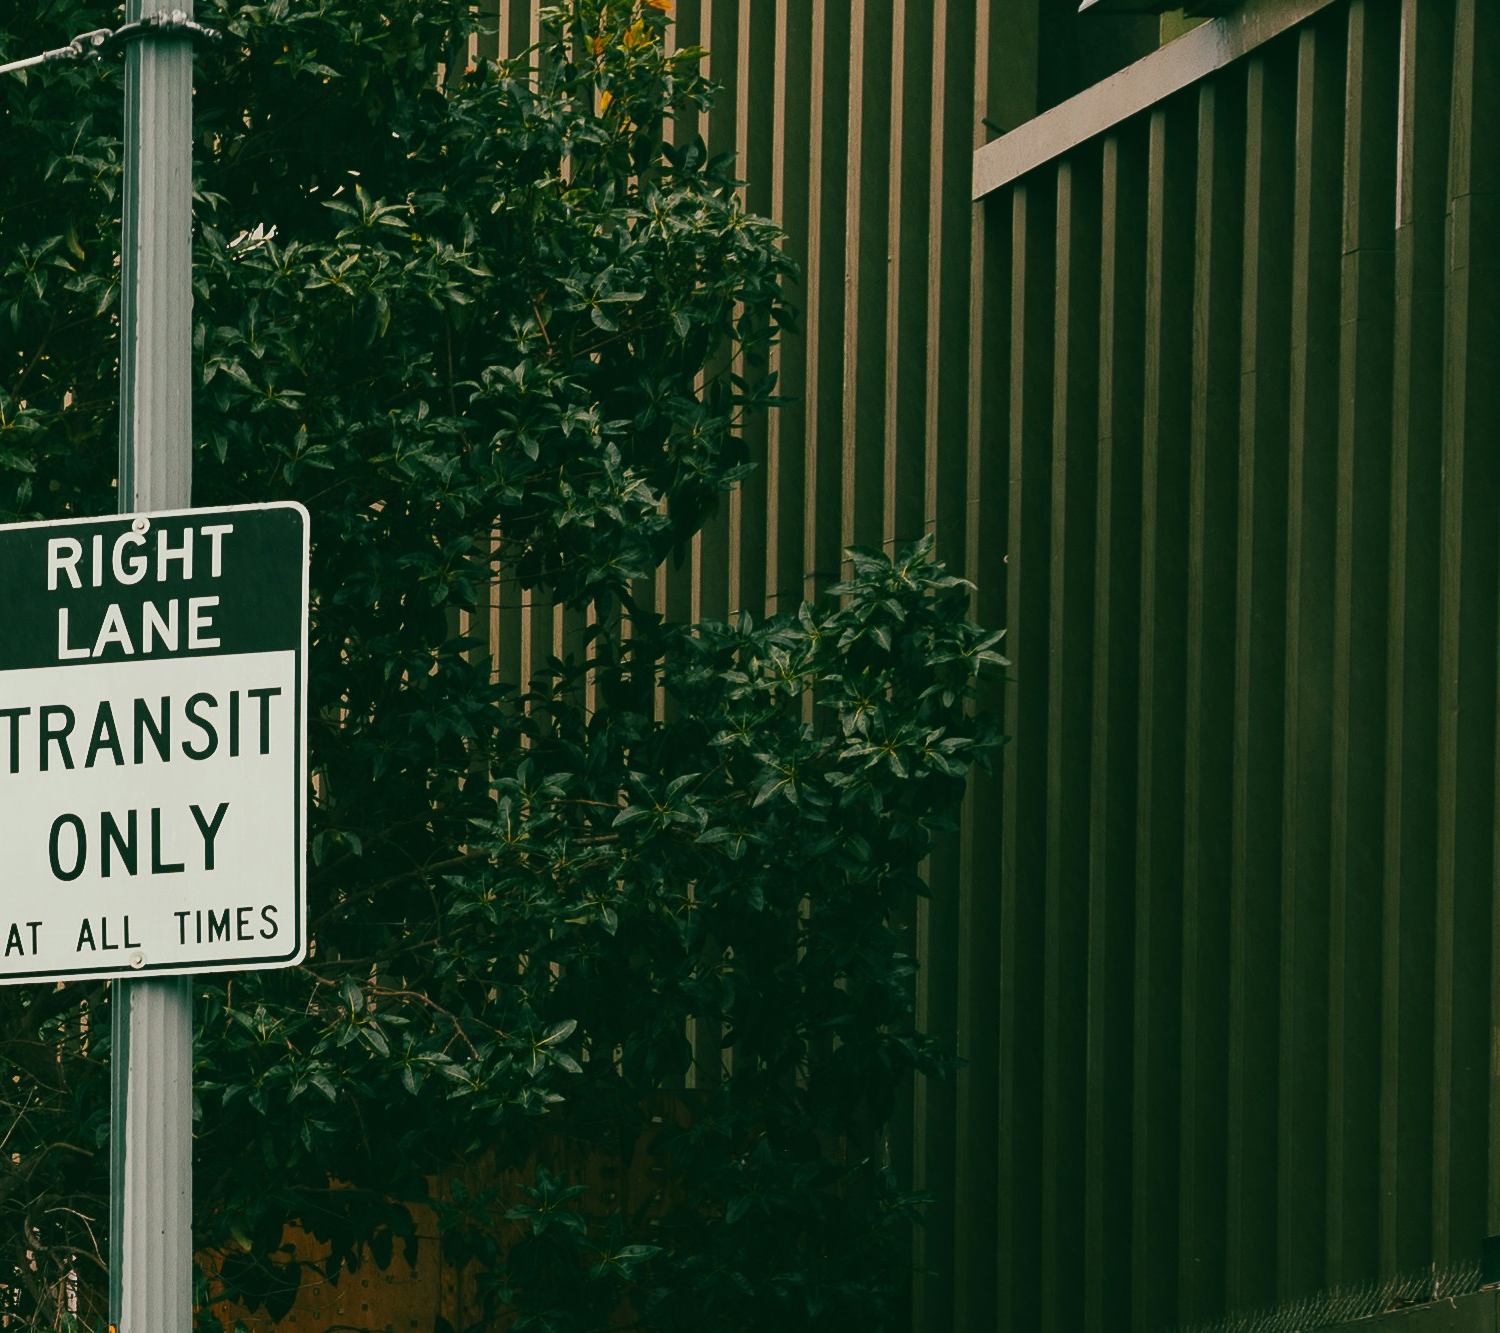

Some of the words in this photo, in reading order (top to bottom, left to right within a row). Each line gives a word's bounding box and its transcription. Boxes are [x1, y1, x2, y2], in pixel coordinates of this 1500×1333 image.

[47, 523, 234, 591] RIGHT
[58, 596, 222, 660] LANE
[48, 802, 230, 882] ONLY
[4, 921, 43, 957] AT
[76, 915, 141, 952] ALL
[174, 904, 279, 945] TIMES
